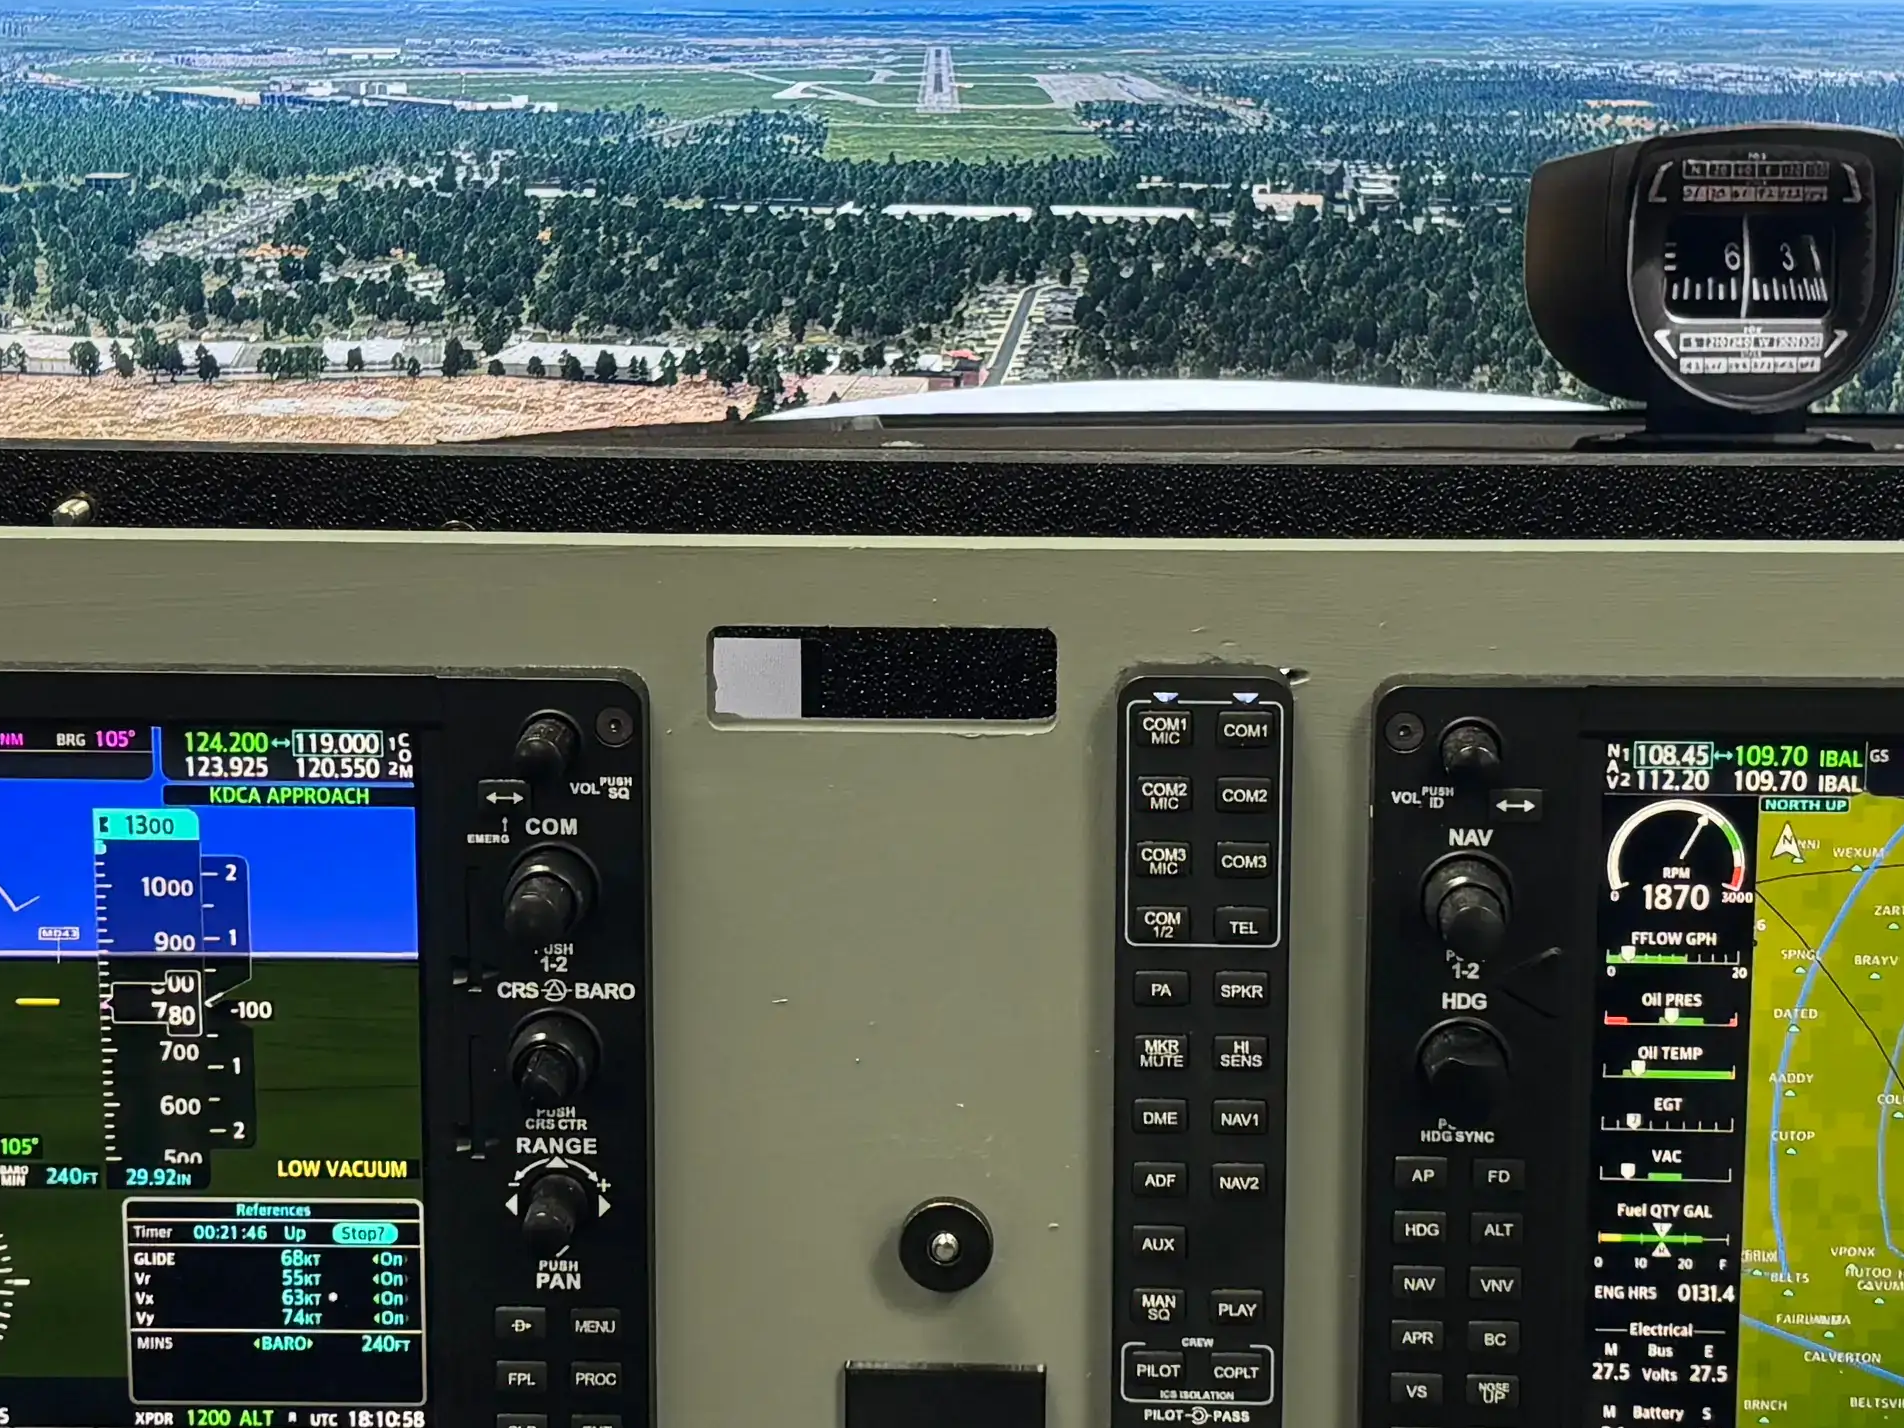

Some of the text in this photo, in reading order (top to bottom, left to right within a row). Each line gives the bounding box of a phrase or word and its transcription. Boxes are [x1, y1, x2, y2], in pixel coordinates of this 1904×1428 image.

[1224, 724, 1268, 738] COM1
[185, 732, 379, 754] 124.200 119.000
[1637, 745, 1862, 767] 108.45 109.70 IBAL
[186, 758, 379, 778] 123.925 120.550
[209, 787, 369, 804] KDCA APPROACH
[126, 817, 174, 834] 1300
[525, 818, 578, 836] COM
[1449, 829, 1493, 846] NAV
[1222, 855, 1267, 868] COM3
[1663, 867, 1690, 880] RPM
[1643, 885, 1709, 910] 1870
[1230, 921, 1258, 934] TEL
[1632, 932, 1717, 946] FFLOW GPH
[497, 982, 635, 1000] CRS BARO
[1220, 985, 1263, 998] SPKR
[1221, 1113, 1259, 1127] NAV1
[516, 1137, 596, 1155] RANGE
[278, 1161, 407, 1178] LOW VACUUM
[1219, 1177, 1259, 1190] NAV2
[237, 1204, 310, 1216] References
[133, 1226, 384, 1242] Timer 00:21:46 Up Stop?
[134, 1253, 175, 1265] GLIDE
[536, 1274, 581, 1290] PAN
[1595, 1284, 1734, 1302] ENG HRS 0131.4
[1219, 1303, 1256, 1317] PLAY
[575, 1319, 616, 1334] MENU
[1630, 1322, 1693, 1337] Electrical
[1214, 1366, 1258, 1379] COPLT
[135, 1410, 425, 1427] XPDR 1200 ALT UTC 18:10:58
[1145, 1409, 1249, 1422] PILOT PASS
[1633, 1406, 1684, 1424] Battery
